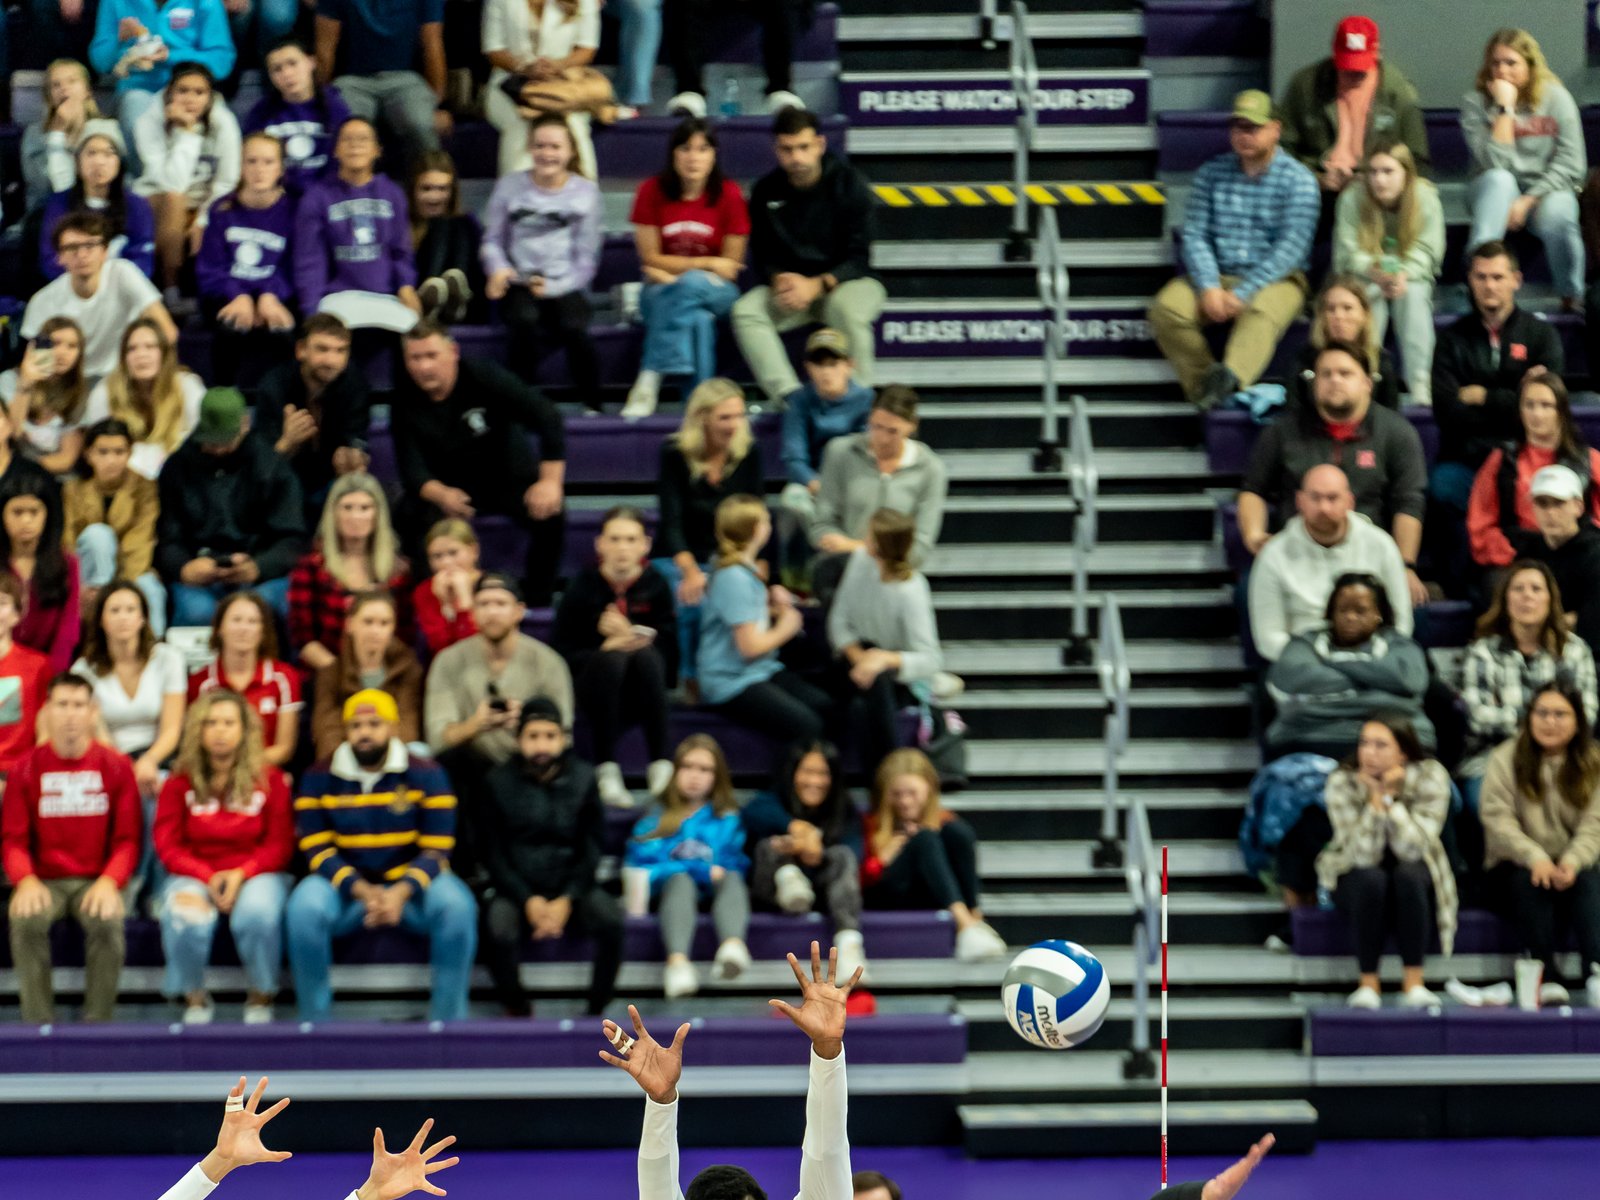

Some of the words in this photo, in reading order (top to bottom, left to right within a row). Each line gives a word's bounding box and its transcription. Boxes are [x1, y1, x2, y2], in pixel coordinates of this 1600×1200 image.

[859, 90, 942, 112] PLEASE
[943, 89, 1018, 111] WATCH
[1022, 88, 1076, 111] OUR
[1076, 87, 1136, 110] STEP
[882, 321, 965, 343] PLEASE
[967, 320, 1046, 342] WATCH
[1050, 320, 1105, 341] OUR
[1105, 319, 1156, 341] STE
[1037, 1005, 1063, 1047] molte
